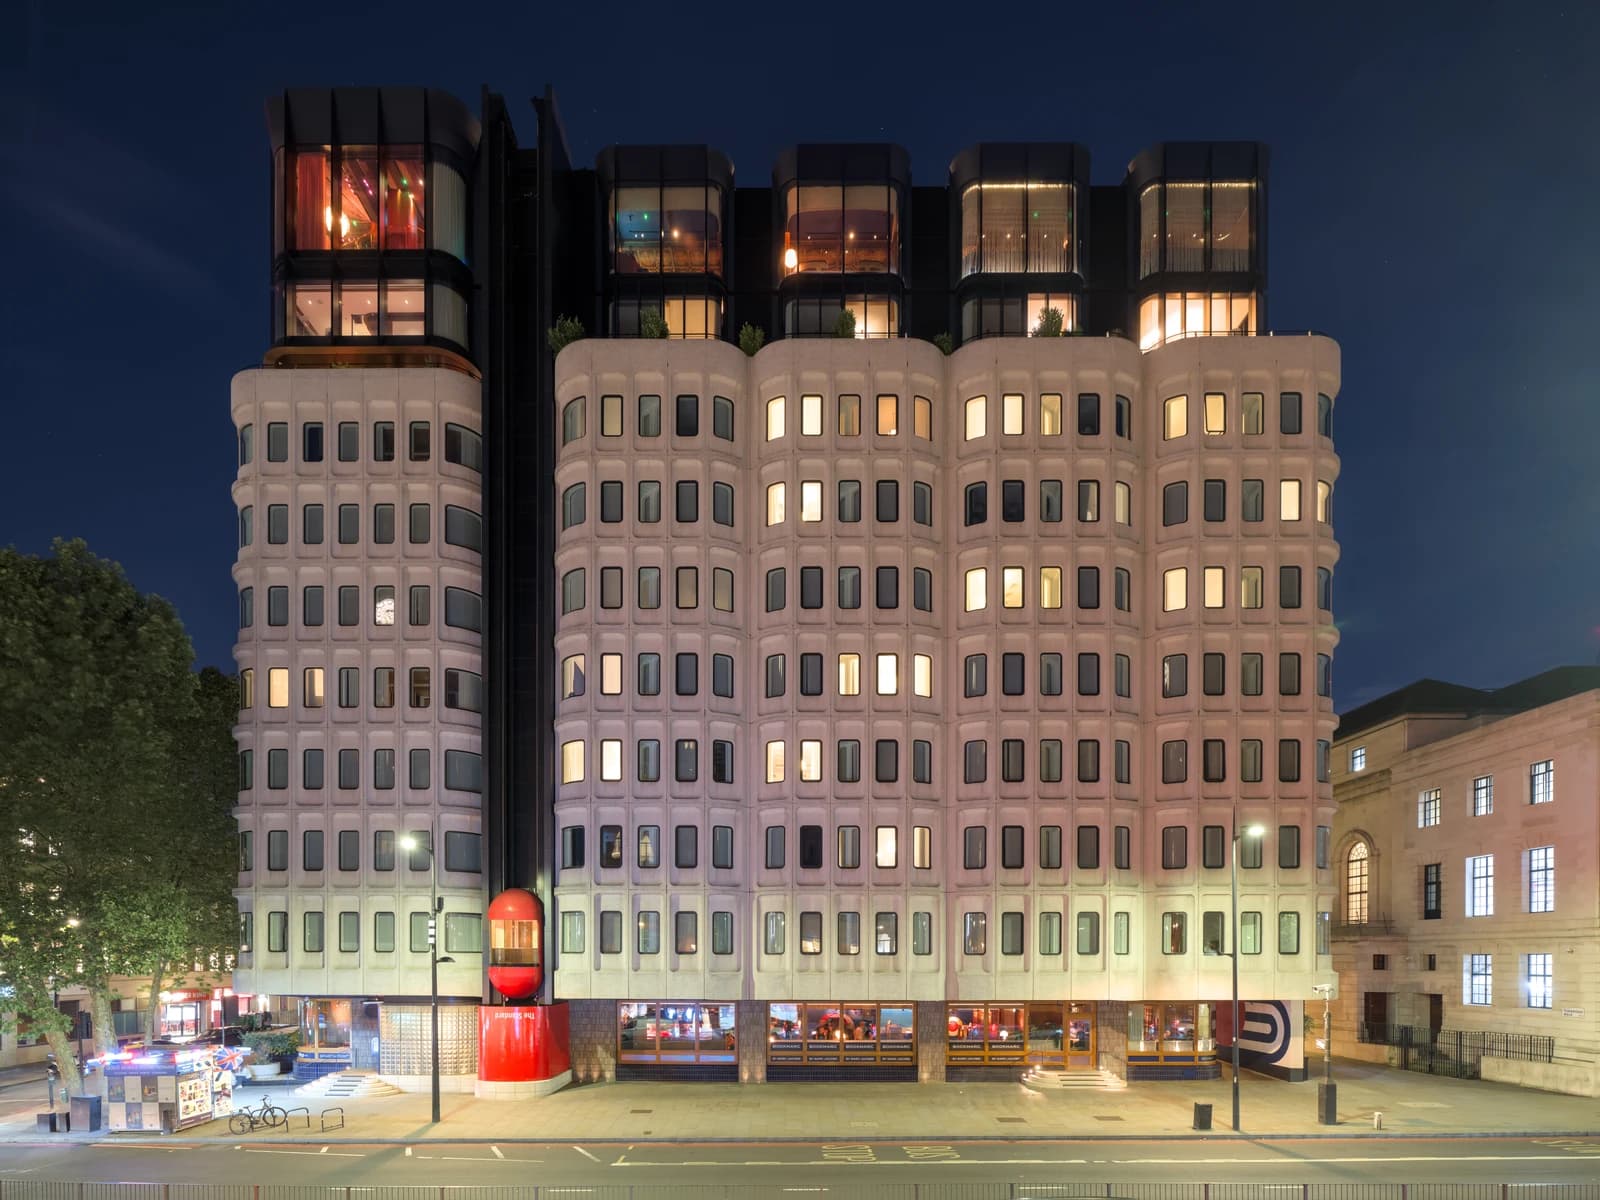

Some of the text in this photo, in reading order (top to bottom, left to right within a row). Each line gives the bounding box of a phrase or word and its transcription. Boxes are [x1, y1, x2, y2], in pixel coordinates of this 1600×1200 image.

[494, 1012, 535, 1020] The Standard
[821, 1144, 877, 1162] STOP
